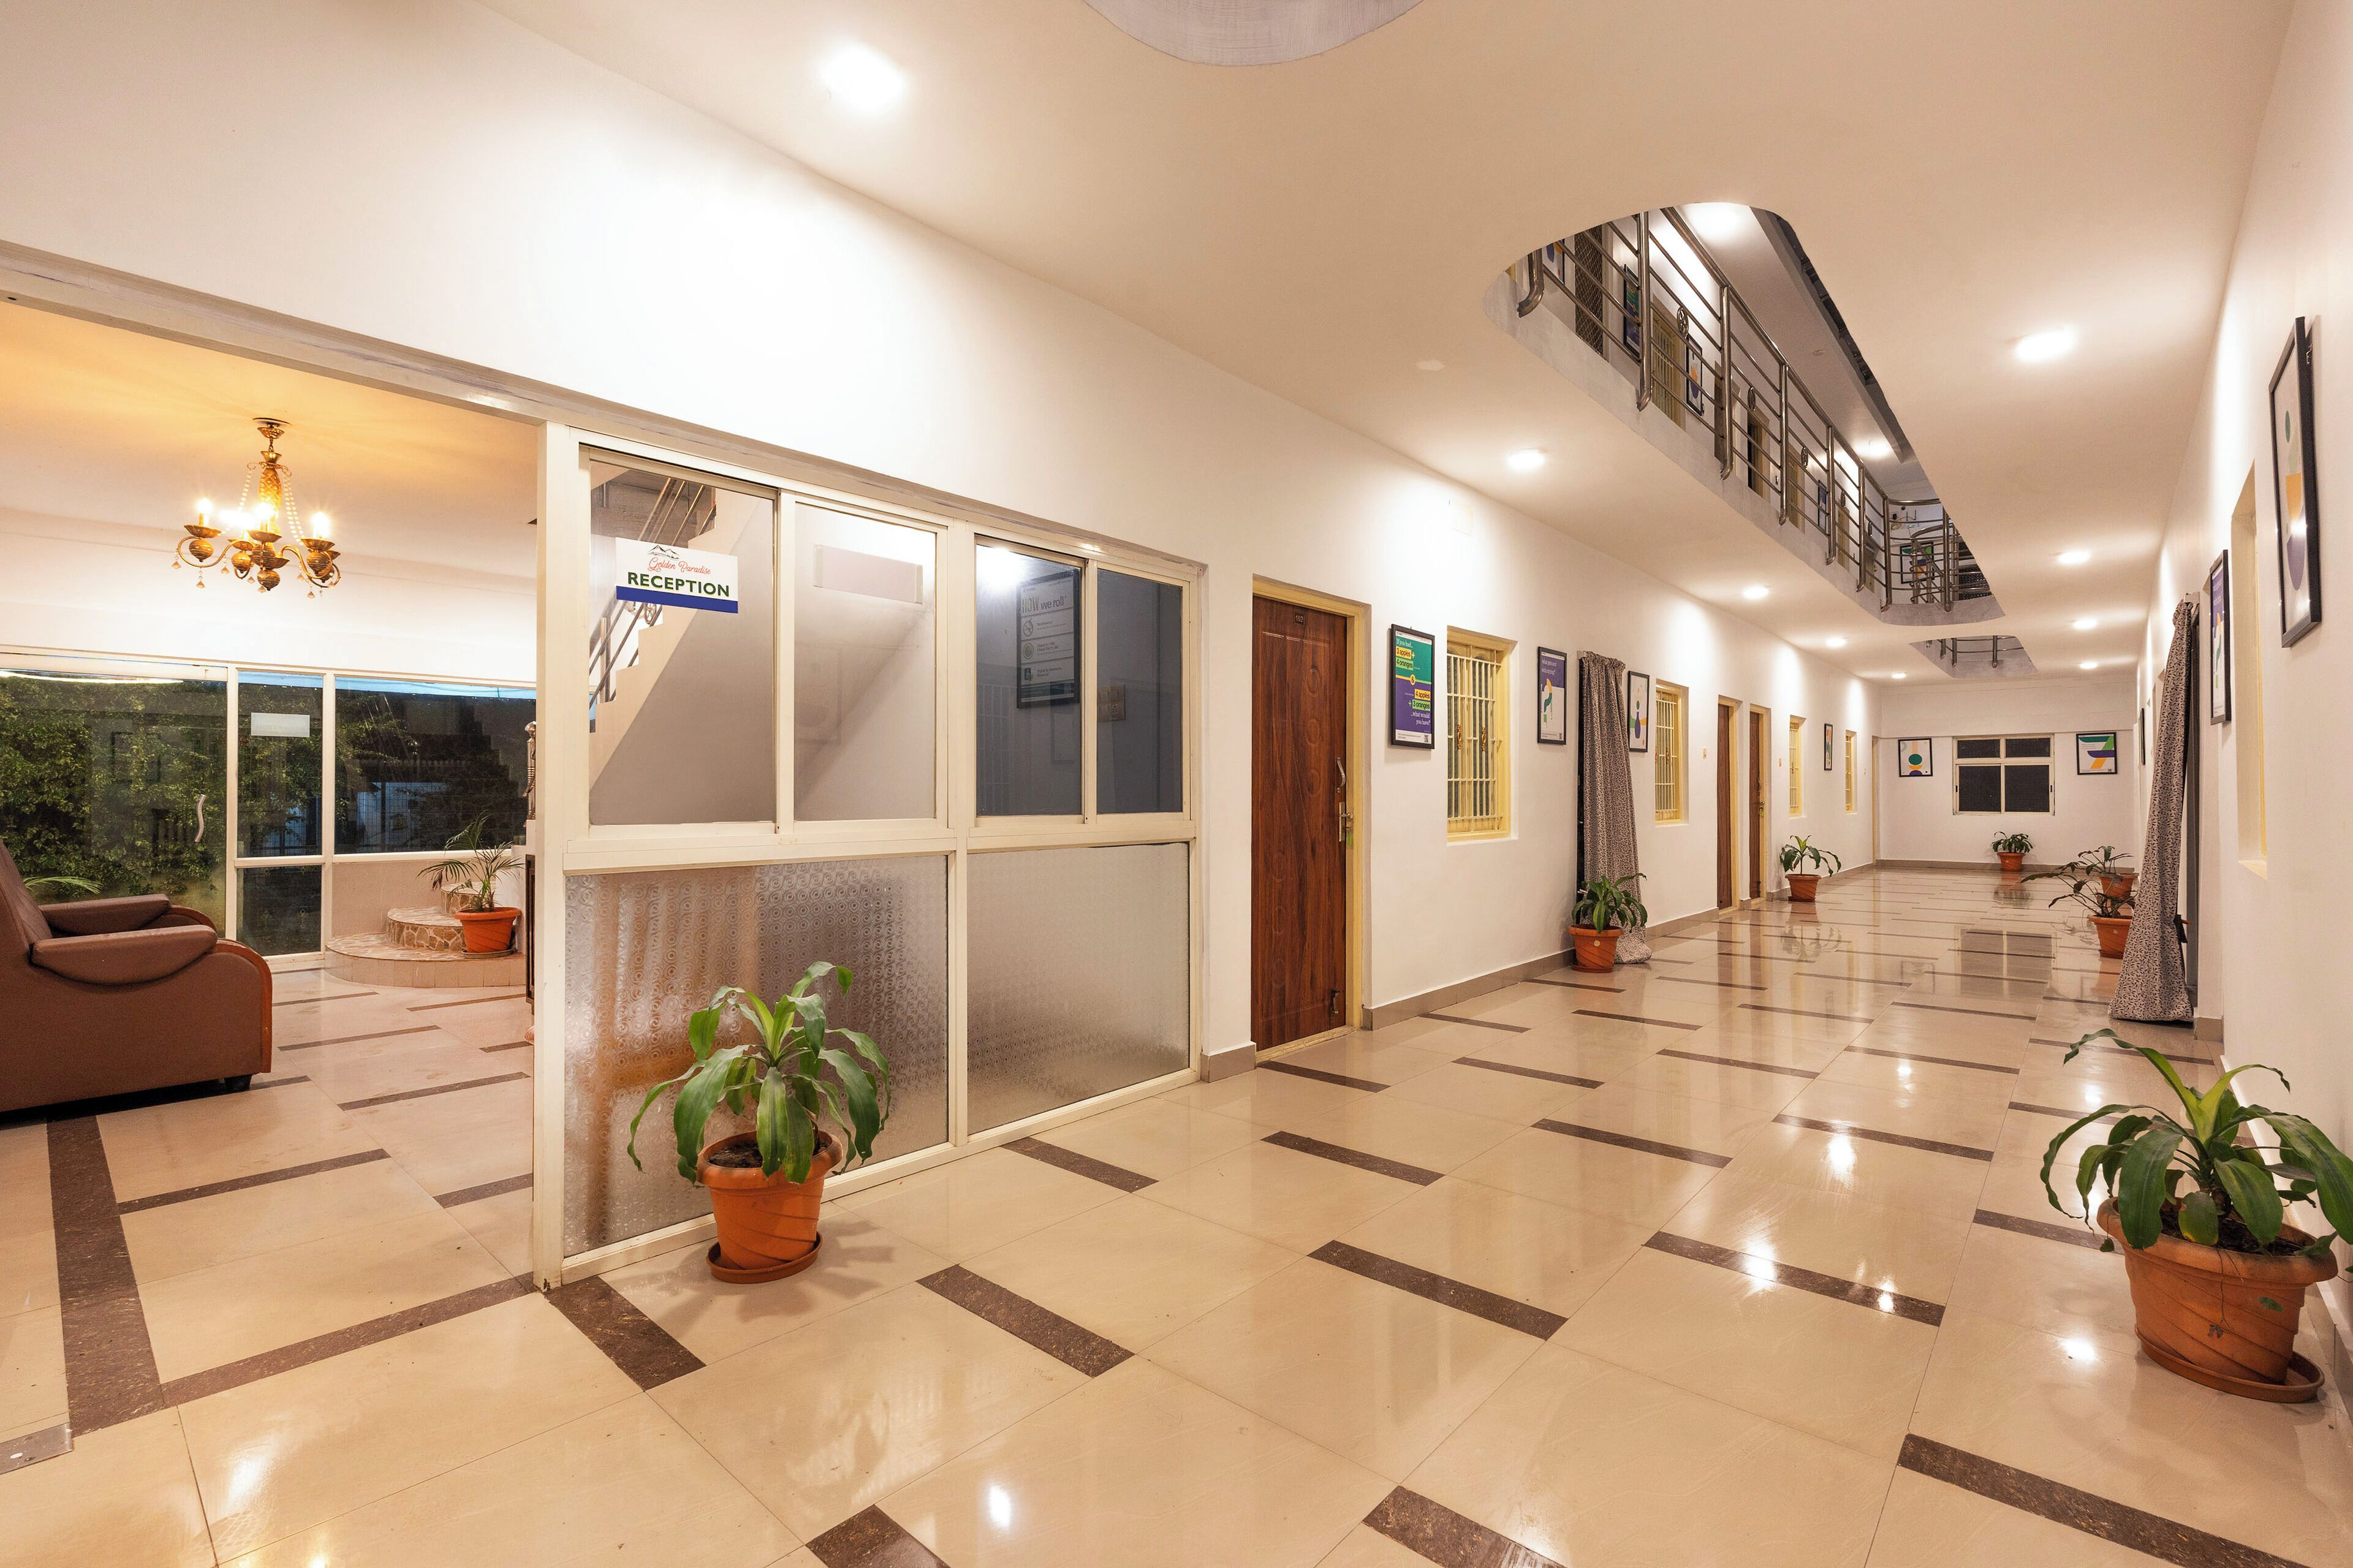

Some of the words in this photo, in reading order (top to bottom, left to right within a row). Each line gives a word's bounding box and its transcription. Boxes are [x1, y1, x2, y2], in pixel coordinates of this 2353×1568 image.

[648, 556, 676, 572] Golden
[678, 561, 711, 575] Paradise
[627, 572, 729, 597] RECEPTION
[1040, 601, 1052, 610] we
